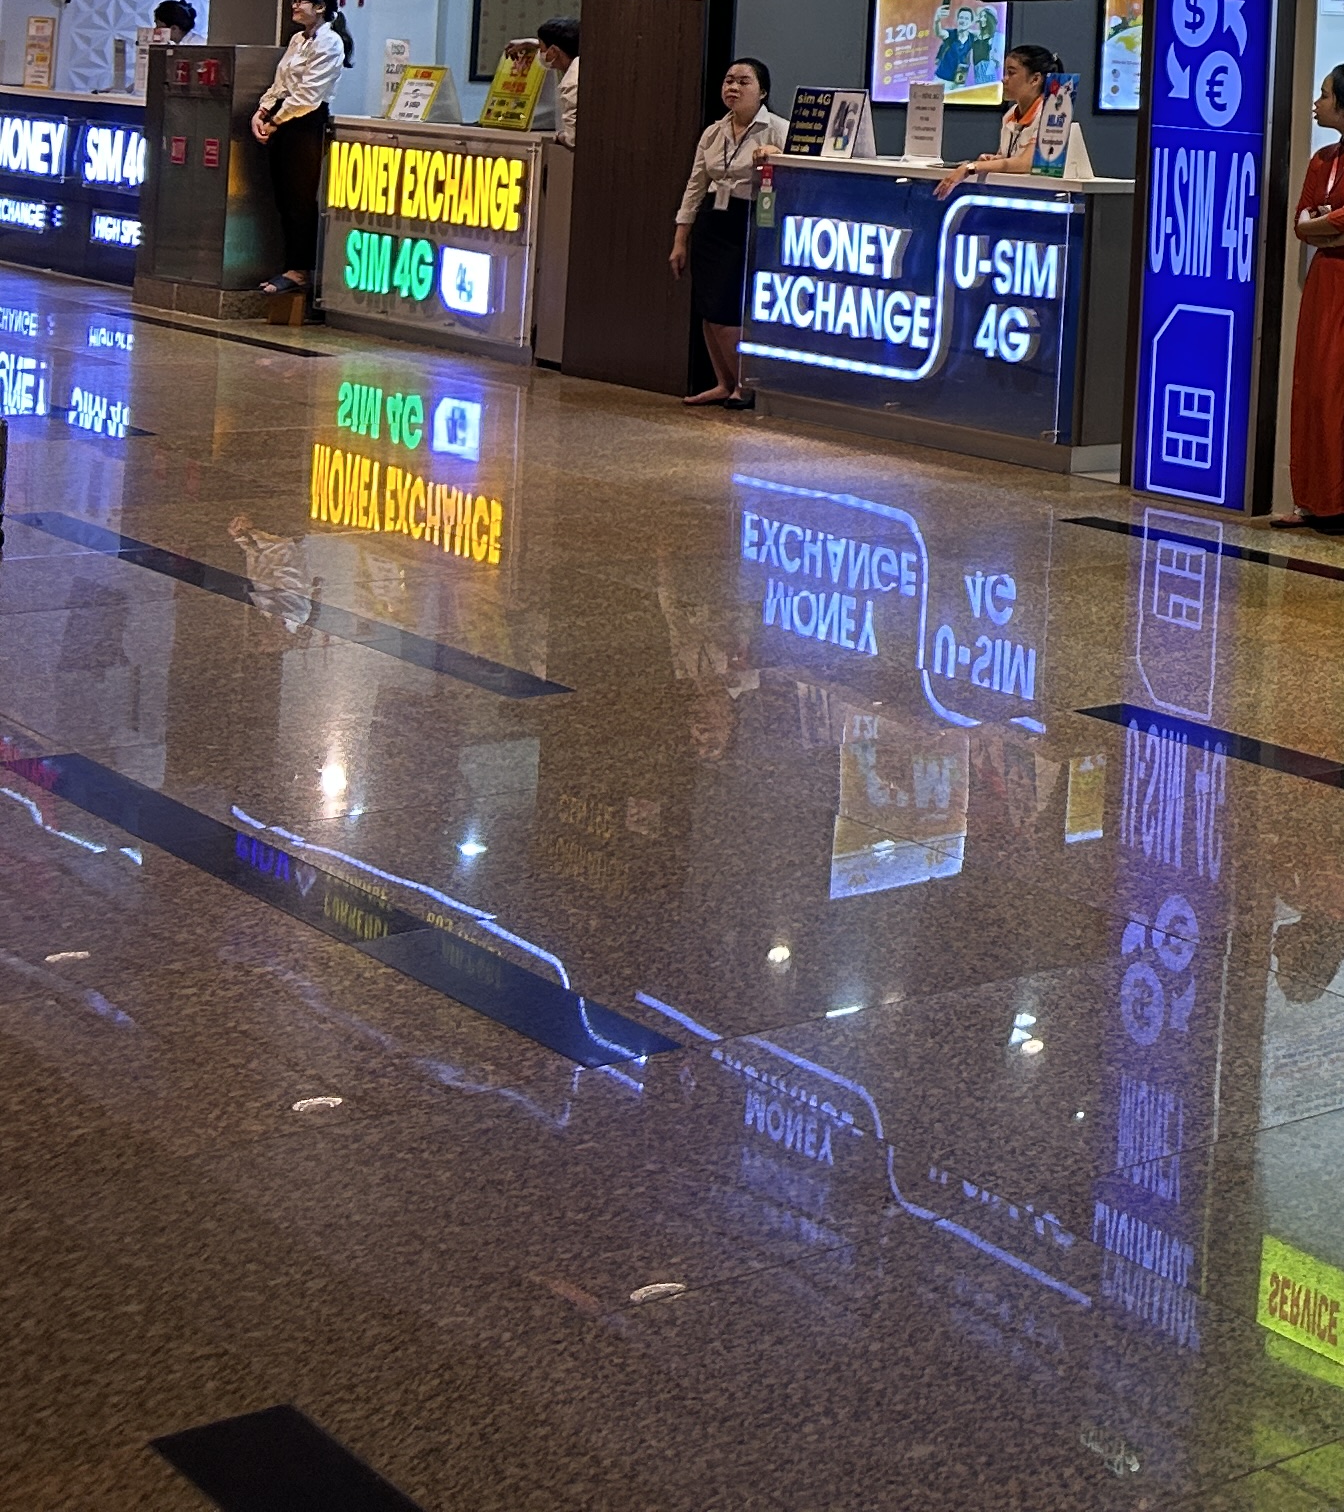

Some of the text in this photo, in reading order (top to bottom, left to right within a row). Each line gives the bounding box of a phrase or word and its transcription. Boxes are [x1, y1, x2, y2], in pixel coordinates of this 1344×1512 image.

[884, 23, 917, 44] 120
[84, 126, 124, 183] SIM
[328, 140, 523, 232] MONEY EXCHANGE
[1151, 147, 1255, 282] U-SIM 4G
[344, 229, 434, 301] SIM 4G
[783, 216, 901, 279] MONEY
[954, 234, 1058, 299] U-SIM
[753, 271, 931, 349] EXCHANGE
[974, 304, 1031, 363] 4G
